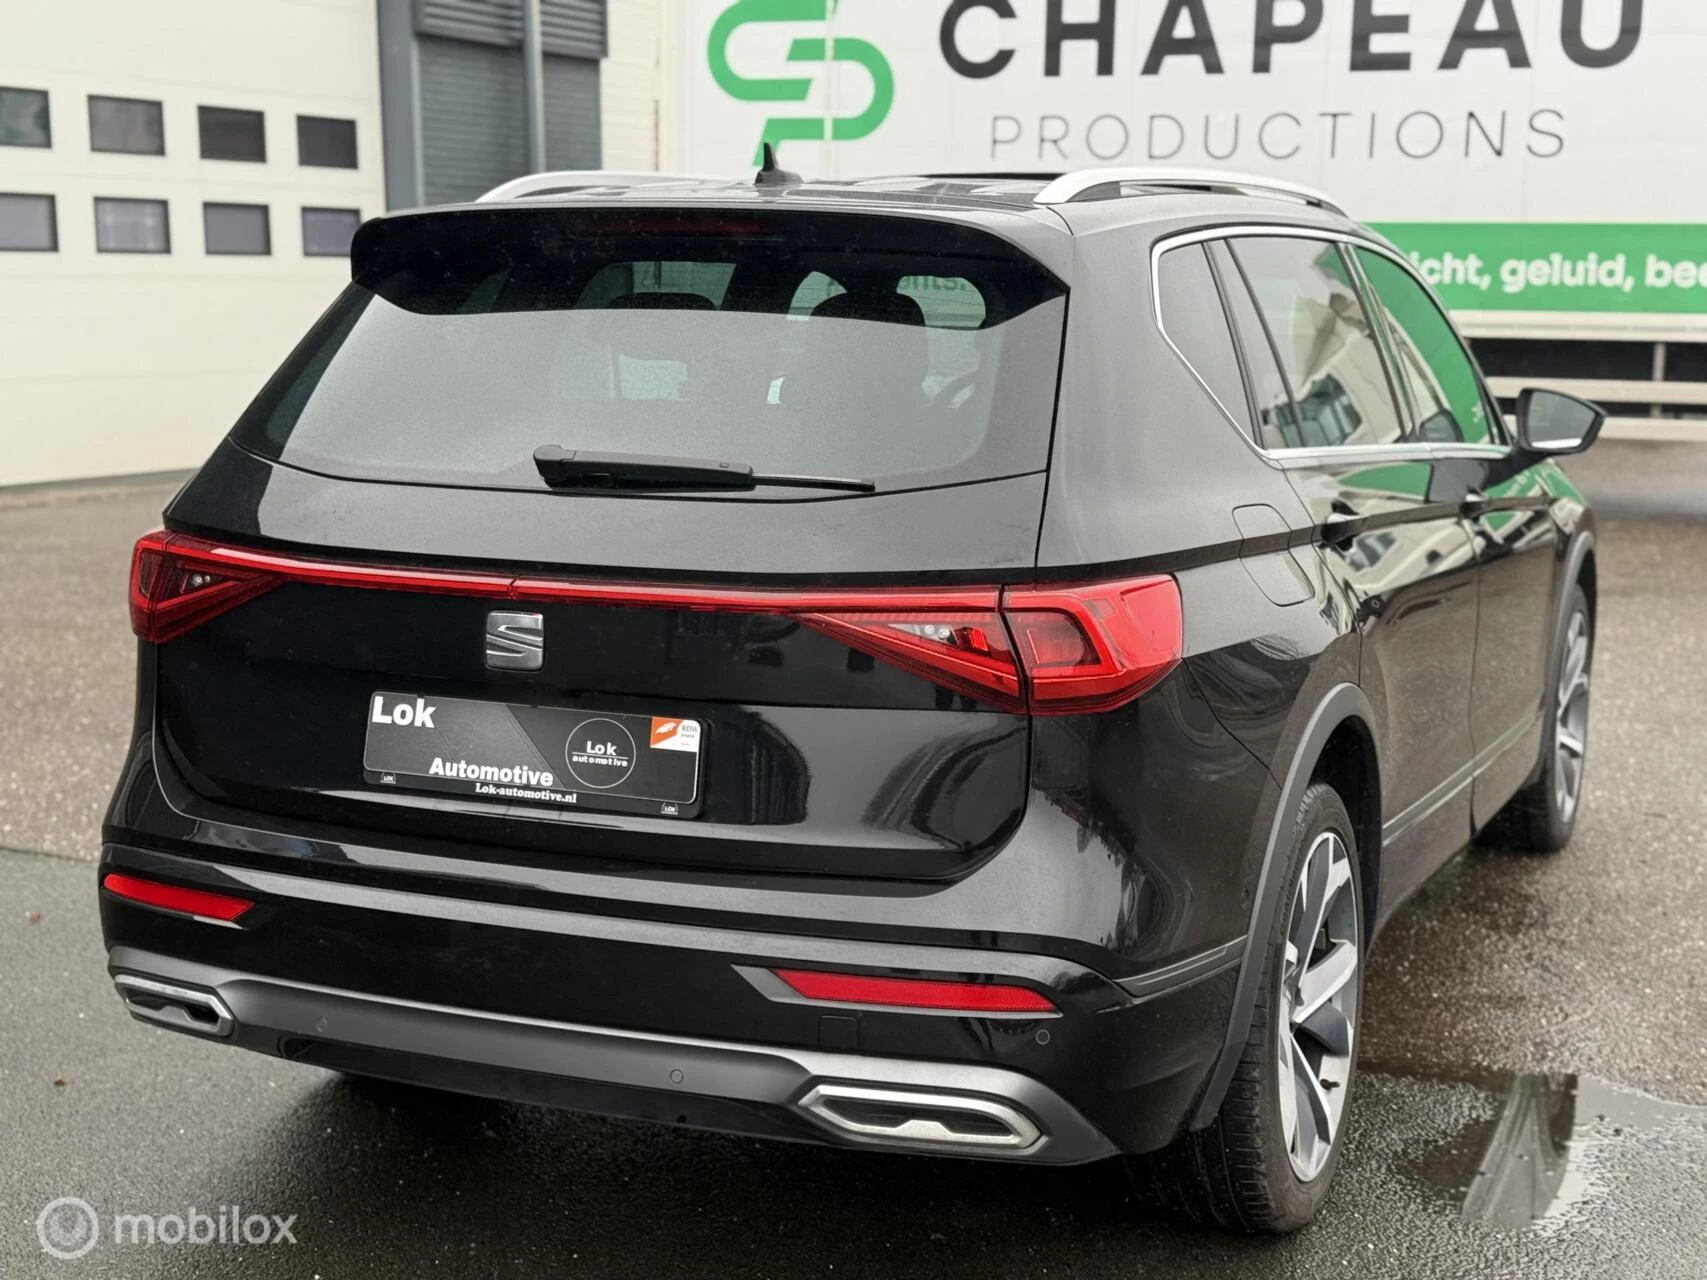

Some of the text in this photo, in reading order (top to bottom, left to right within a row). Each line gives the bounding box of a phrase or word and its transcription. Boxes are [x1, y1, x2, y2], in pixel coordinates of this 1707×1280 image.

[939, 0, 1644, 79] CHAPEAU
[991, 108, 1565, 160] PRODUCTIONS
[1500, 252, 1635, 294] geluid,
[372, 696, 437, 729] Lok
[572, 755, 628, 767] automotive
[586, 740, 617, 756] Lok
[429, 757, 553, 787] Automotive
[475, 782, 577, 804] Lok-automotive.nl
